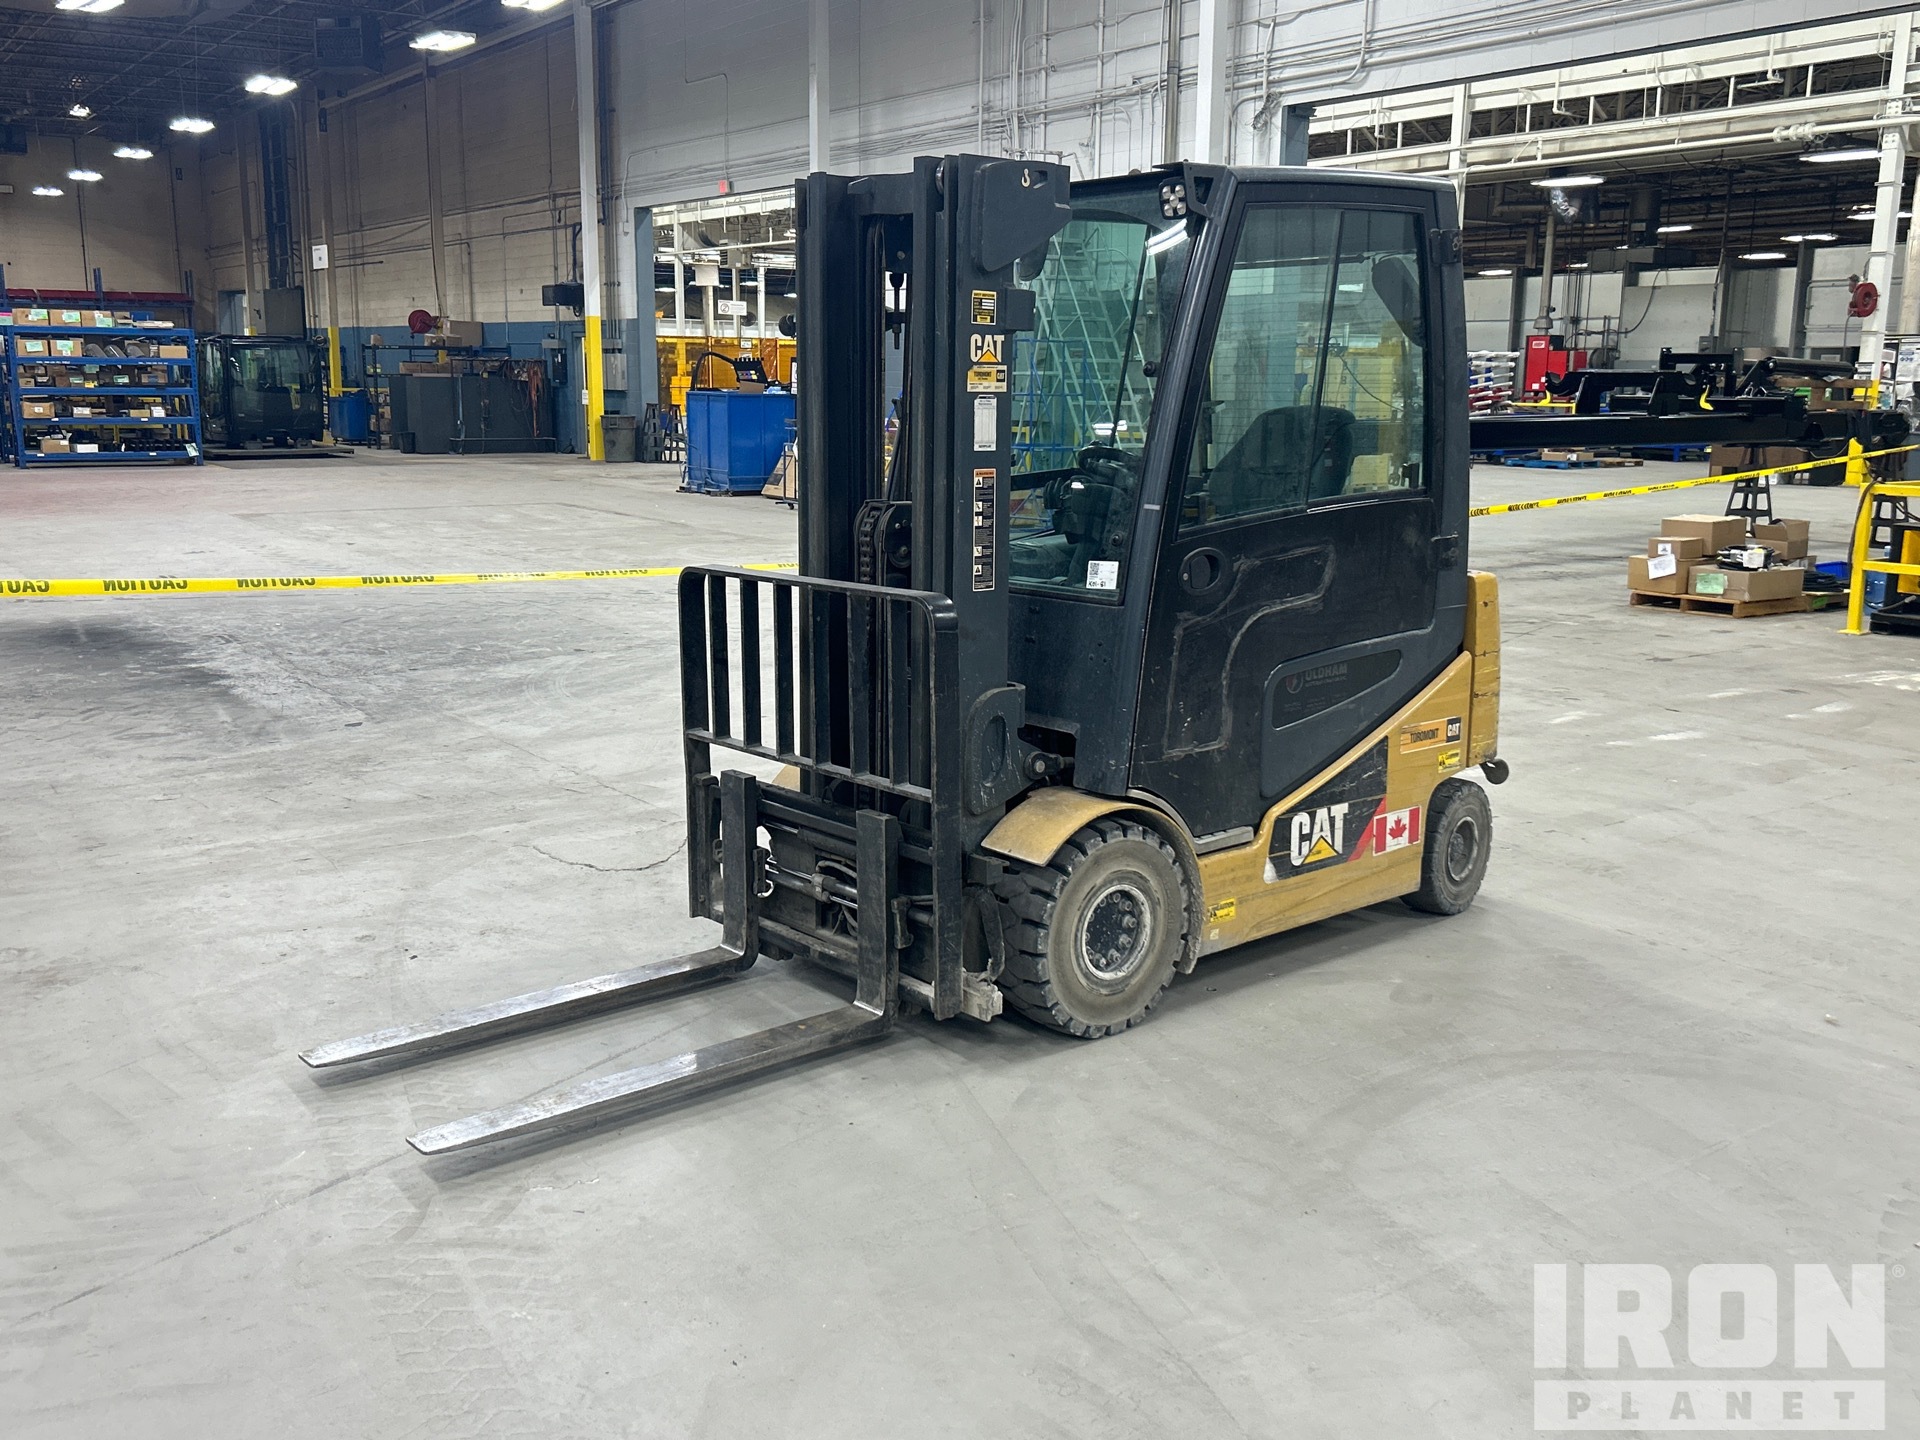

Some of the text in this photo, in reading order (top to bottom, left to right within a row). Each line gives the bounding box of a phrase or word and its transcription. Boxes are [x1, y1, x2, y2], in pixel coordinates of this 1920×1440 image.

[970, 334, 1005, 363] CAT
[1410, 722, 1460, 744] TOROMONT CAT
[1290, 802, 1349, 867] CAT
